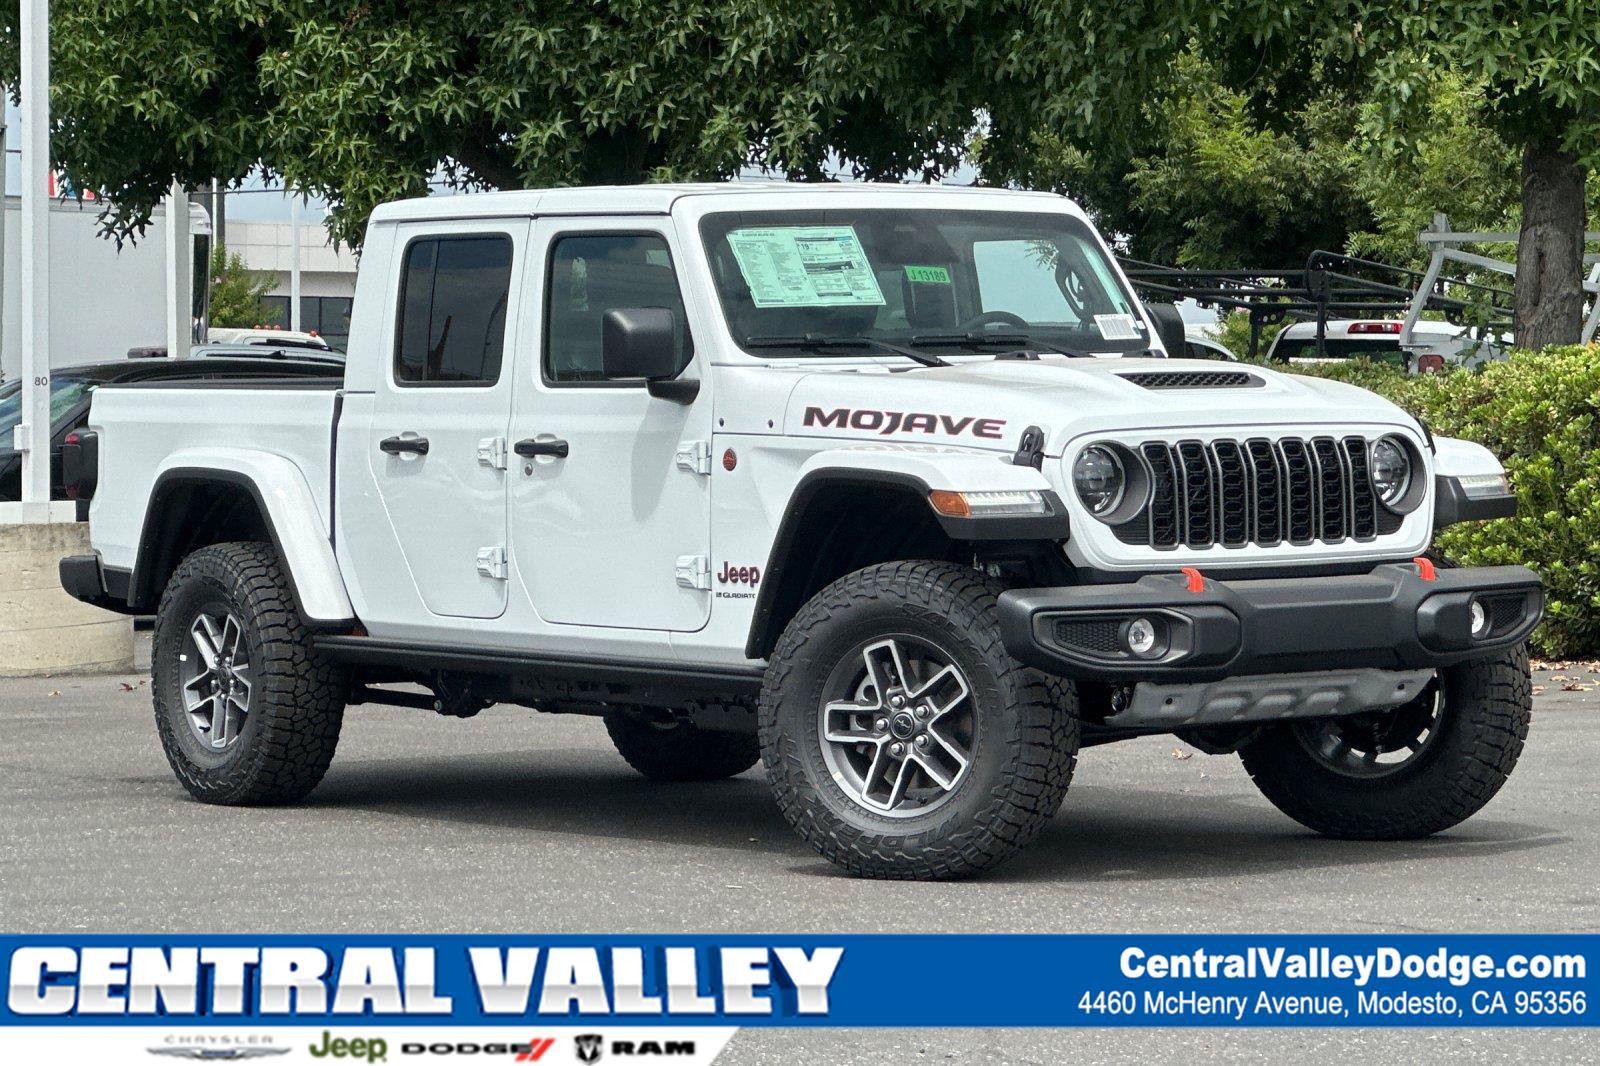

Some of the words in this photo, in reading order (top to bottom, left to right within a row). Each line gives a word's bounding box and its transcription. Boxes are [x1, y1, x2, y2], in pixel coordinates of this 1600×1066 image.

[34, 376, 48, 386] 80
[803, 406, 1007, 440] MOJAVE
[717, 561, 760, 588] Jeep
